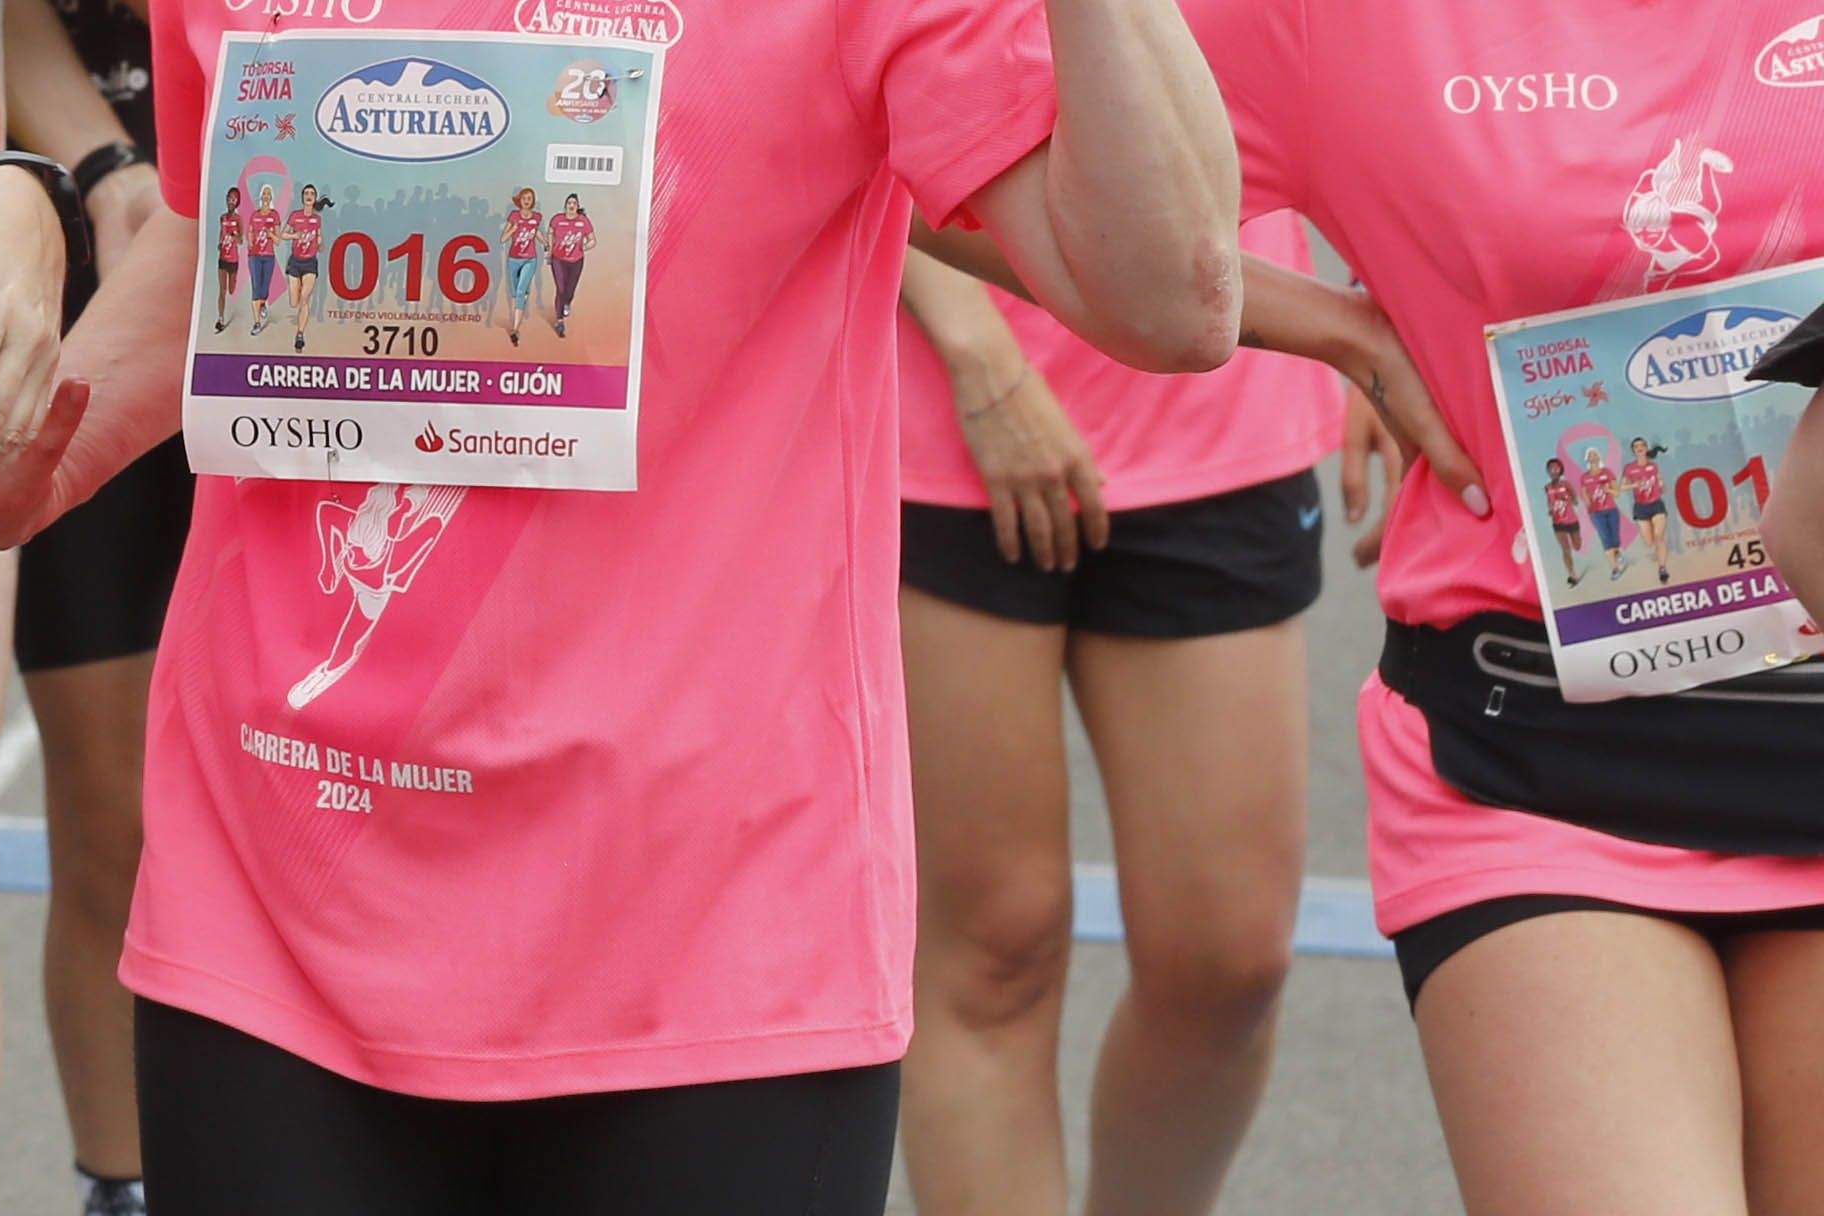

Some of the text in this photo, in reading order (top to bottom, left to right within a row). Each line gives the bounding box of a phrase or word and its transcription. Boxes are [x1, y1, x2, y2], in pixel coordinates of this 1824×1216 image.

[556, 0, 611, 15] CENTRAL
[237, 78, 293, 102] SUMA
[357, 92, 490, 106] CENTRAL LECHERA
[561, 68, 606, 100] 20
[1443, 73, 1619, 114] OYSHO
[327, 93, 495, 137] ASTURIANA
[327, 231, 491, 305] 016
[362, 325, 439, 357] 3710
[1516, 337, 1590, 362] TU DORSAL
[1665, 340, 1726, 356] CENTRAL
[247, 364, 563, 396] CARRERA DE LA MUJER GIJÓN
[1522, 352, 1594, 384] SUMA
[1643, 339, 1778, 390] ASTURIA
[231, 415, 363, 451] OYSHO
[448, 428, 579, 458] Santander
[1727, 540, 1766, 570] 45
[1615, 574, 1780, 625] CARRERA DE LA
[1609, 628, 1745, 679] OYSHO
[240, 722, 475, 794] CARRERA DE LA MUJER
[316, 780, 374, 814] 2024
